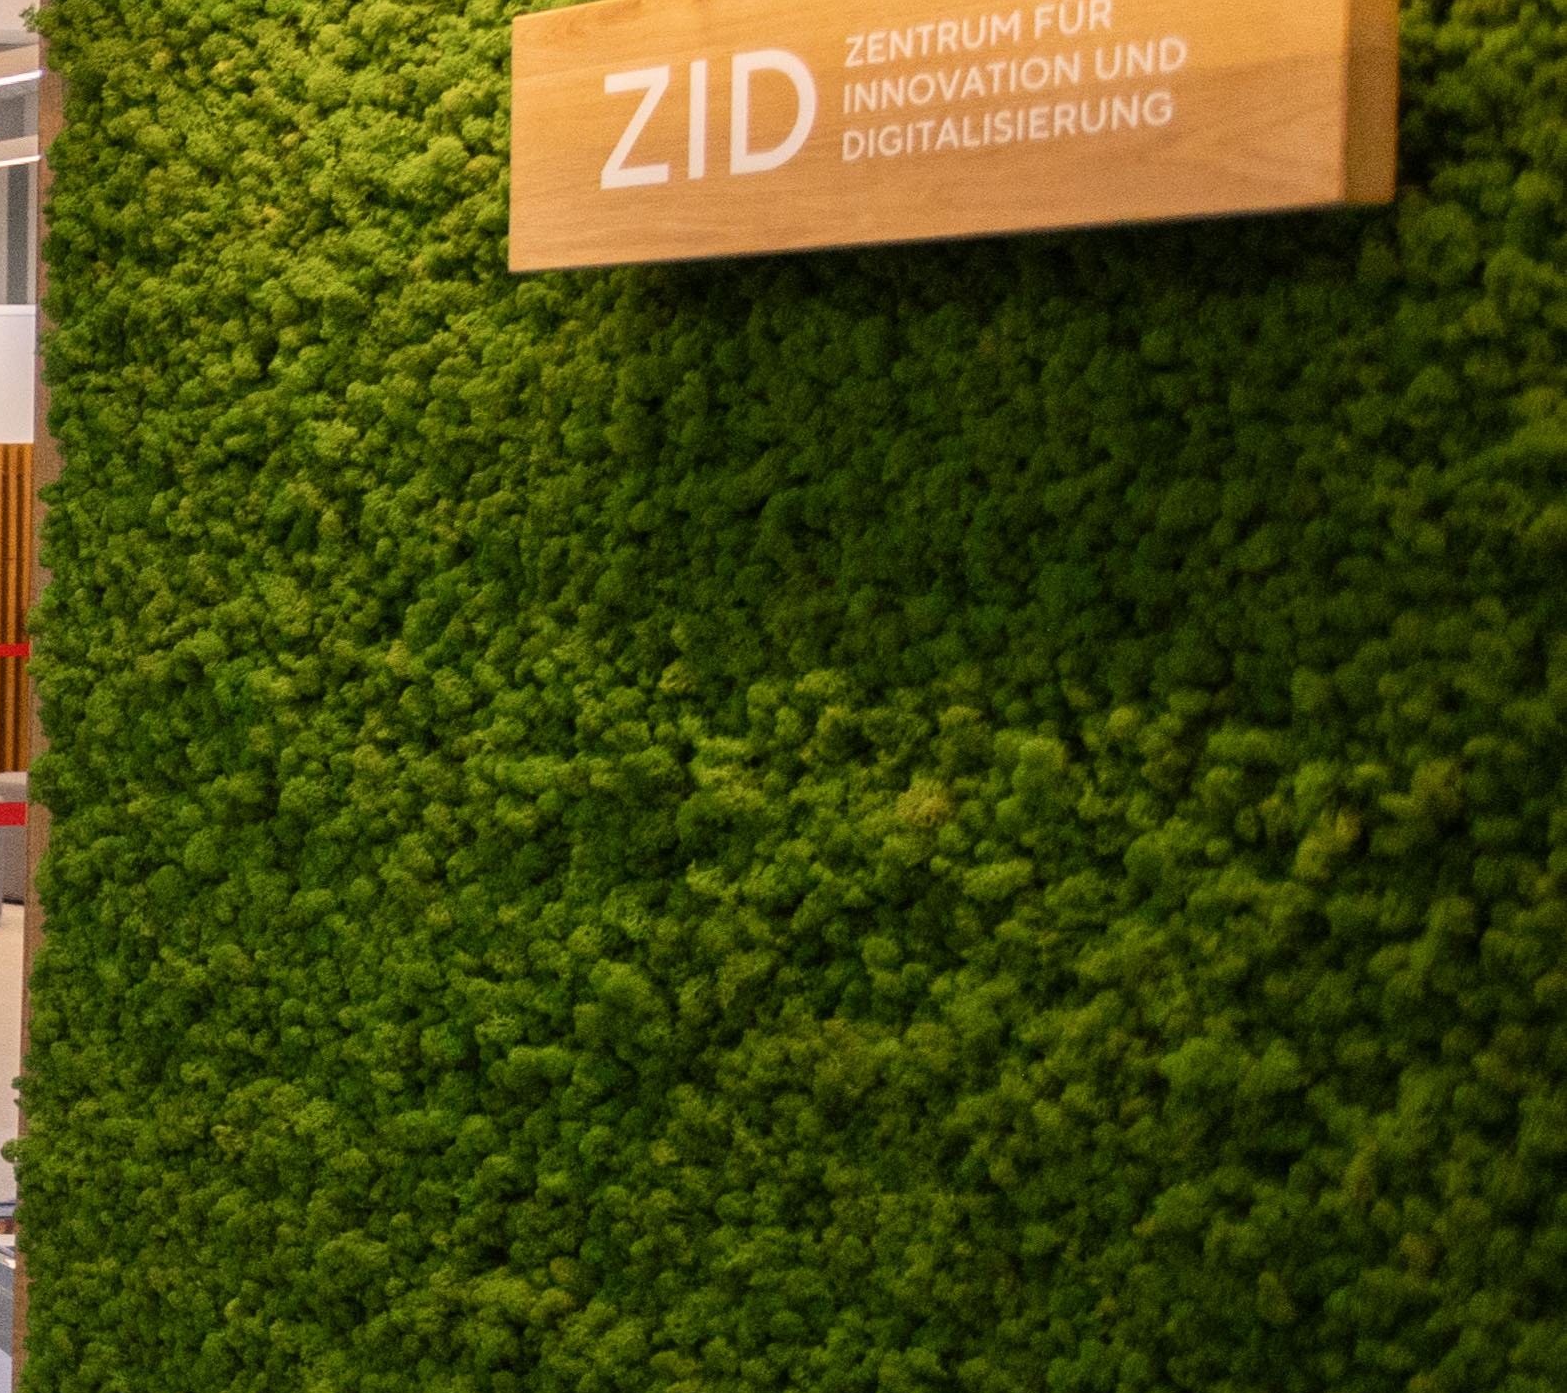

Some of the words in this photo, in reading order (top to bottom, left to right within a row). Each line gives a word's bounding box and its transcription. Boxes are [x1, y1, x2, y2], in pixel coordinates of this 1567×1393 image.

[844, 10, 1021, 68] ZENTRUM
[844, 52, 1080, 114] INNOVATION
[1096, 36, 1187, 79] UND
[601, 49, 816, 190] ZID
[842, 92, 1173, 161] DIGITALISIERUNG
